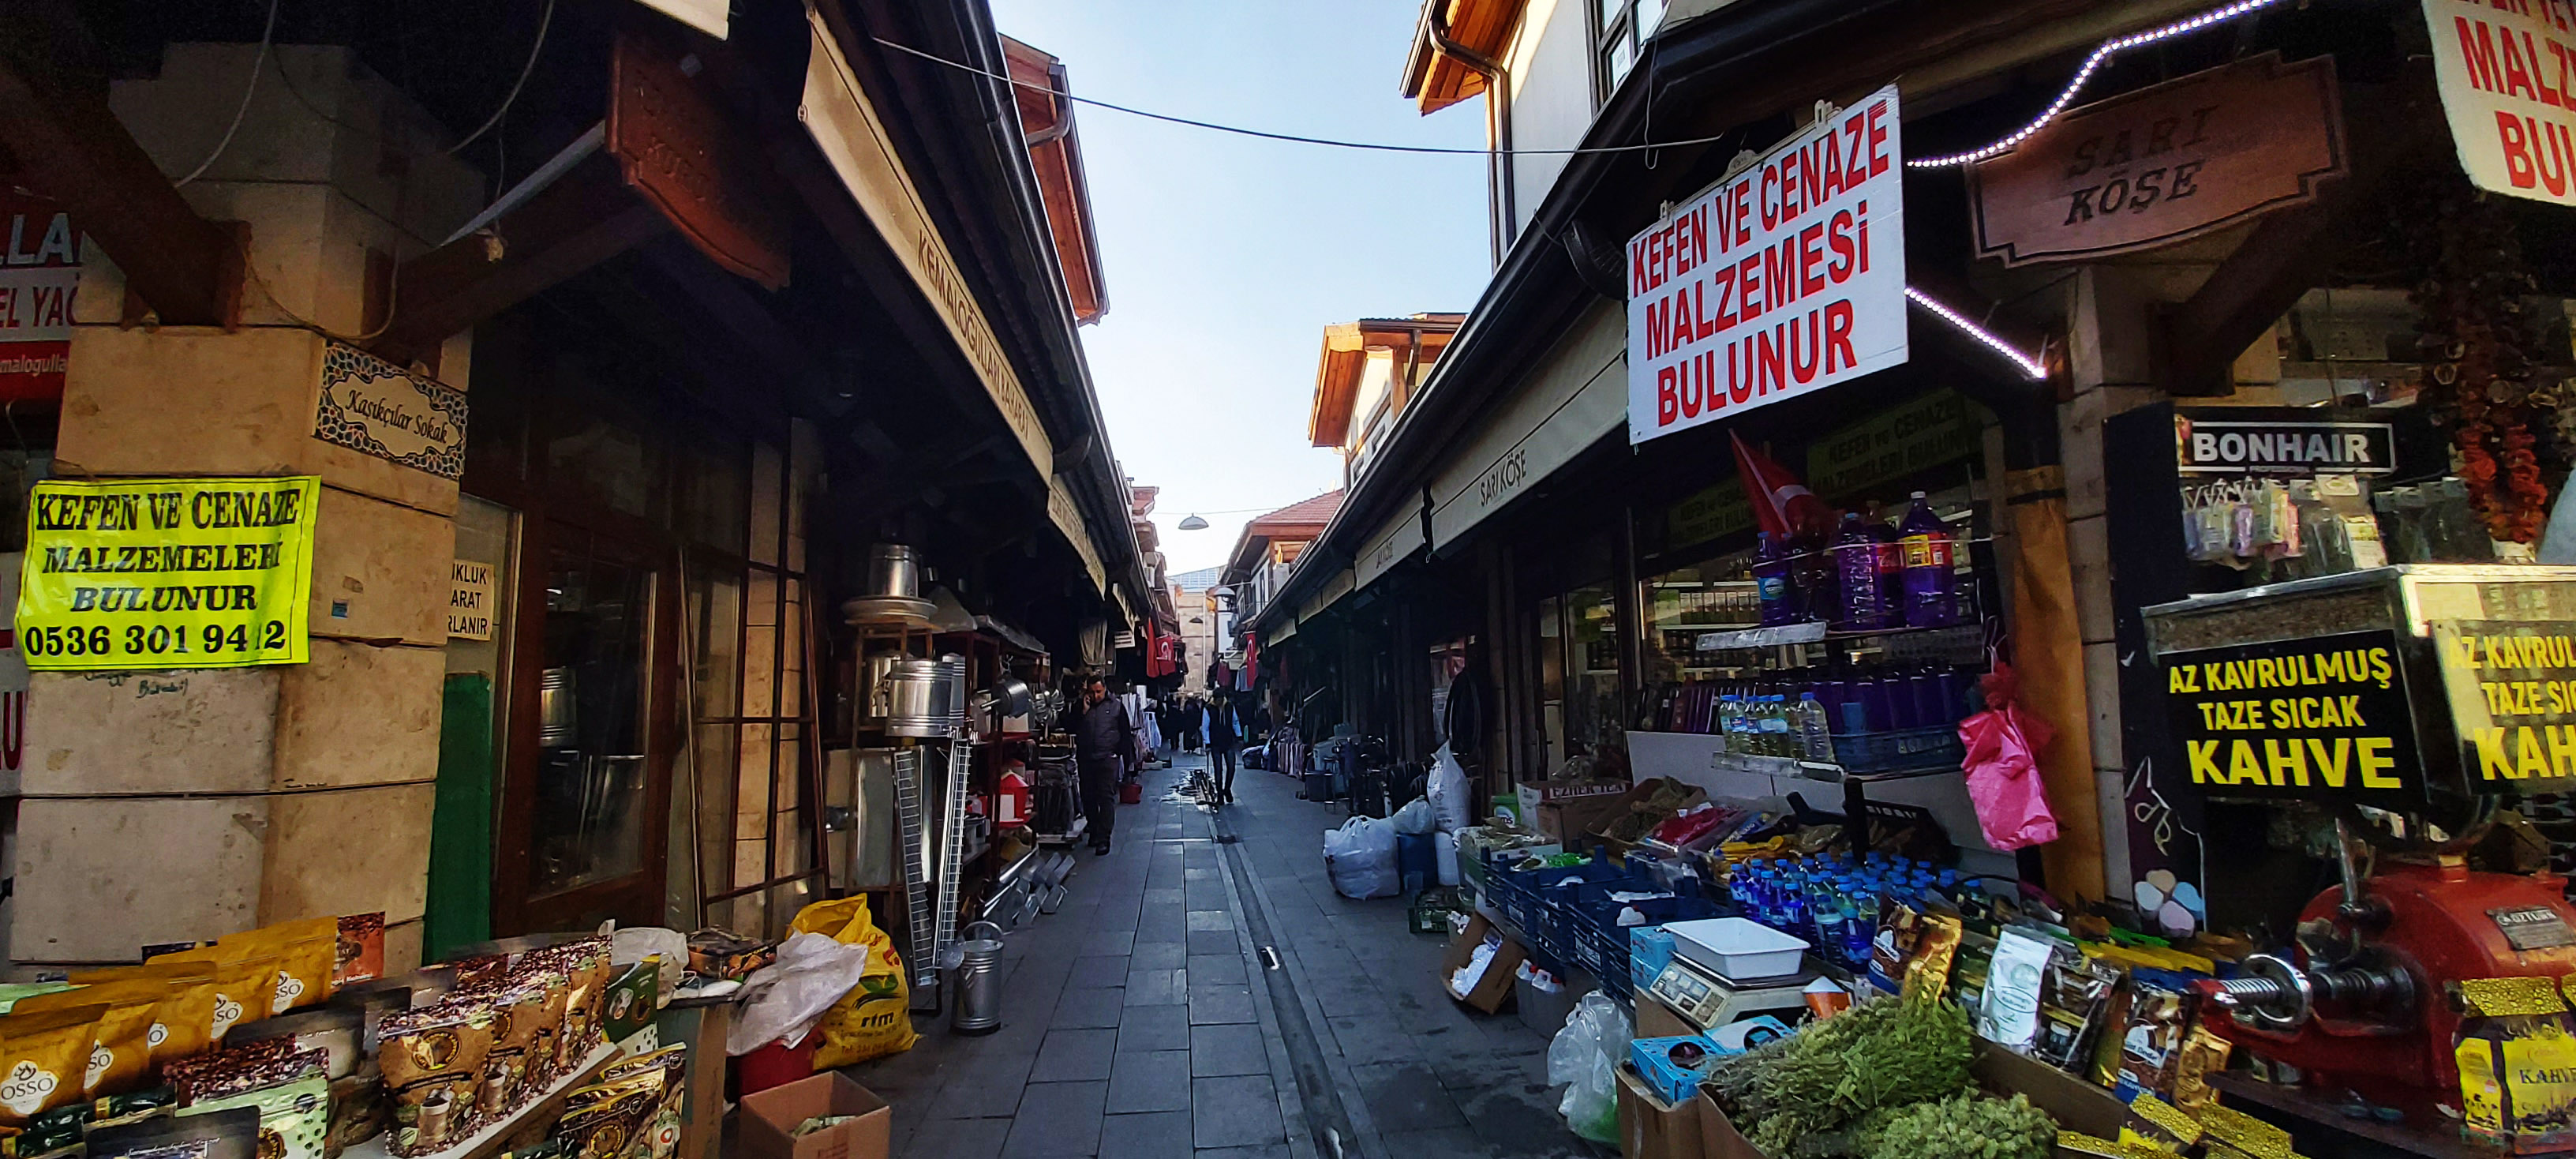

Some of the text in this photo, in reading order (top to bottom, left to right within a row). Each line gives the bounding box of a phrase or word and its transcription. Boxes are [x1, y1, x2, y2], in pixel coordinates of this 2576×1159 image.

[2454, 16, 2576, 112] MALZ
[1633, 99, 1889, 298] KEFEN VE CENAZE
[1646, 199, 1870, 362] MALZEMESİ
[1657, 298, 1857, 427] BULUNUR
[345, 389, 447, 444] Kaşıkçılar Sokak
[2192, 433, 2372, 463] BONHAIR
[1480, 448, 1526, 507] SARI KÖŞE
[36, 488, 301, 531] KEFEN VE CENAZE
[70, 585, 257, 613] BULUNUR
[25, 625, 110, 656] 0536
[125, 625, 189, 655] 301
[203, 623, 247, 654] 94
[2448, 636, 2481, 670] AZ
[2169, 647, 2392, 694] AZ KAVRULMUŞ
[2198, 695, 2367, 731] TAZE SICAK
[2481, 681, 2544, 716] TAZE
[2186, 737, 2402, 789] KAHVE
[861, 1011, 894, 1027] rtm
[1, 1077, 54, 1101] OSSO
